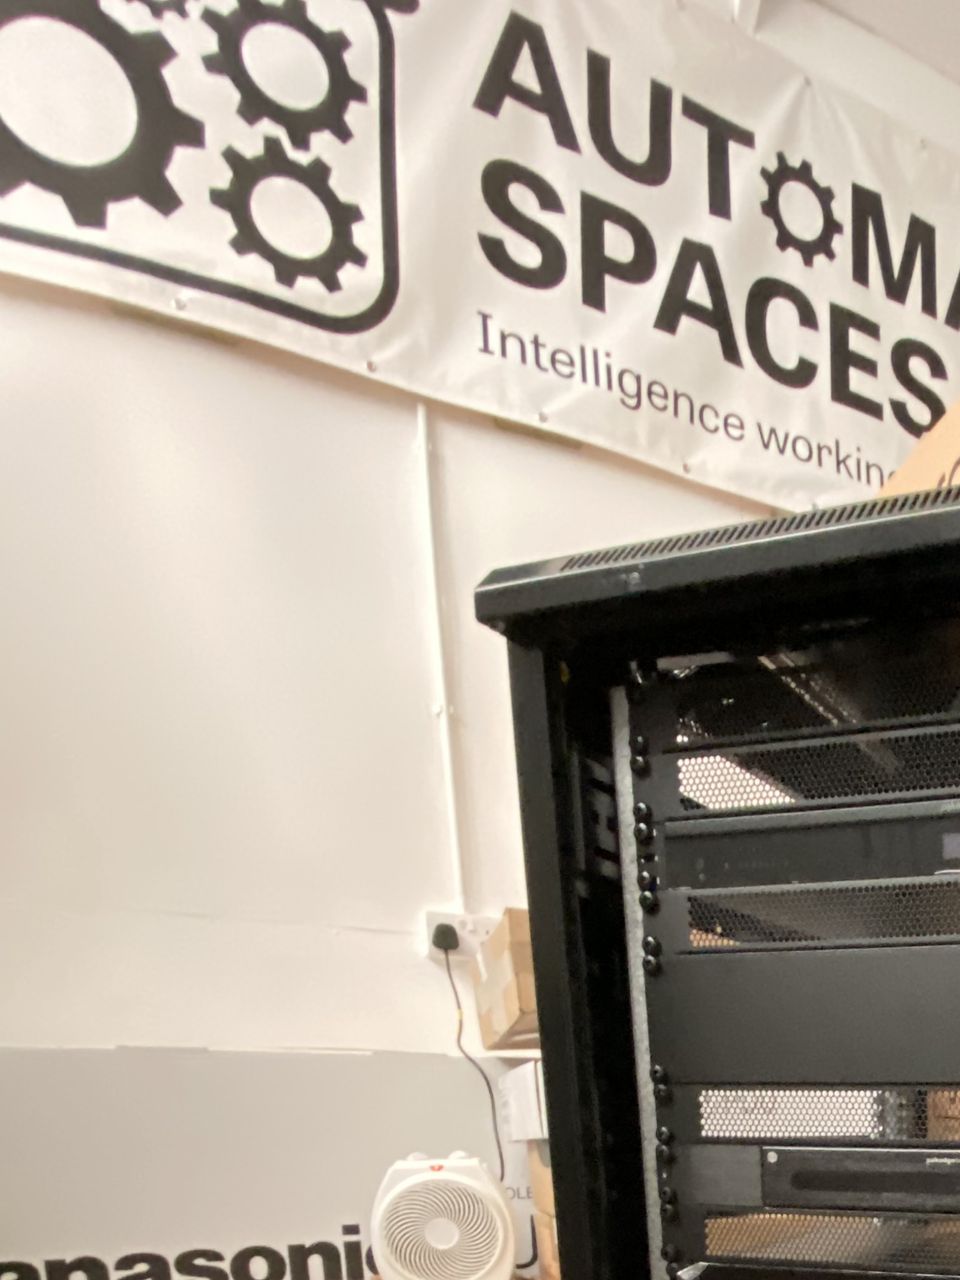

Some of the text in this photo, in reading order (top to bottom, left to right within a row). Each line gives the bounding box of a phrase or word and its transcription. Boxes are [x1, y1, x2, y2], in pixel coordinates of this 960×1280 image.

[477, 158, 948, 438] SPACES
[477, 311, 897, 490] Intelligence workin
